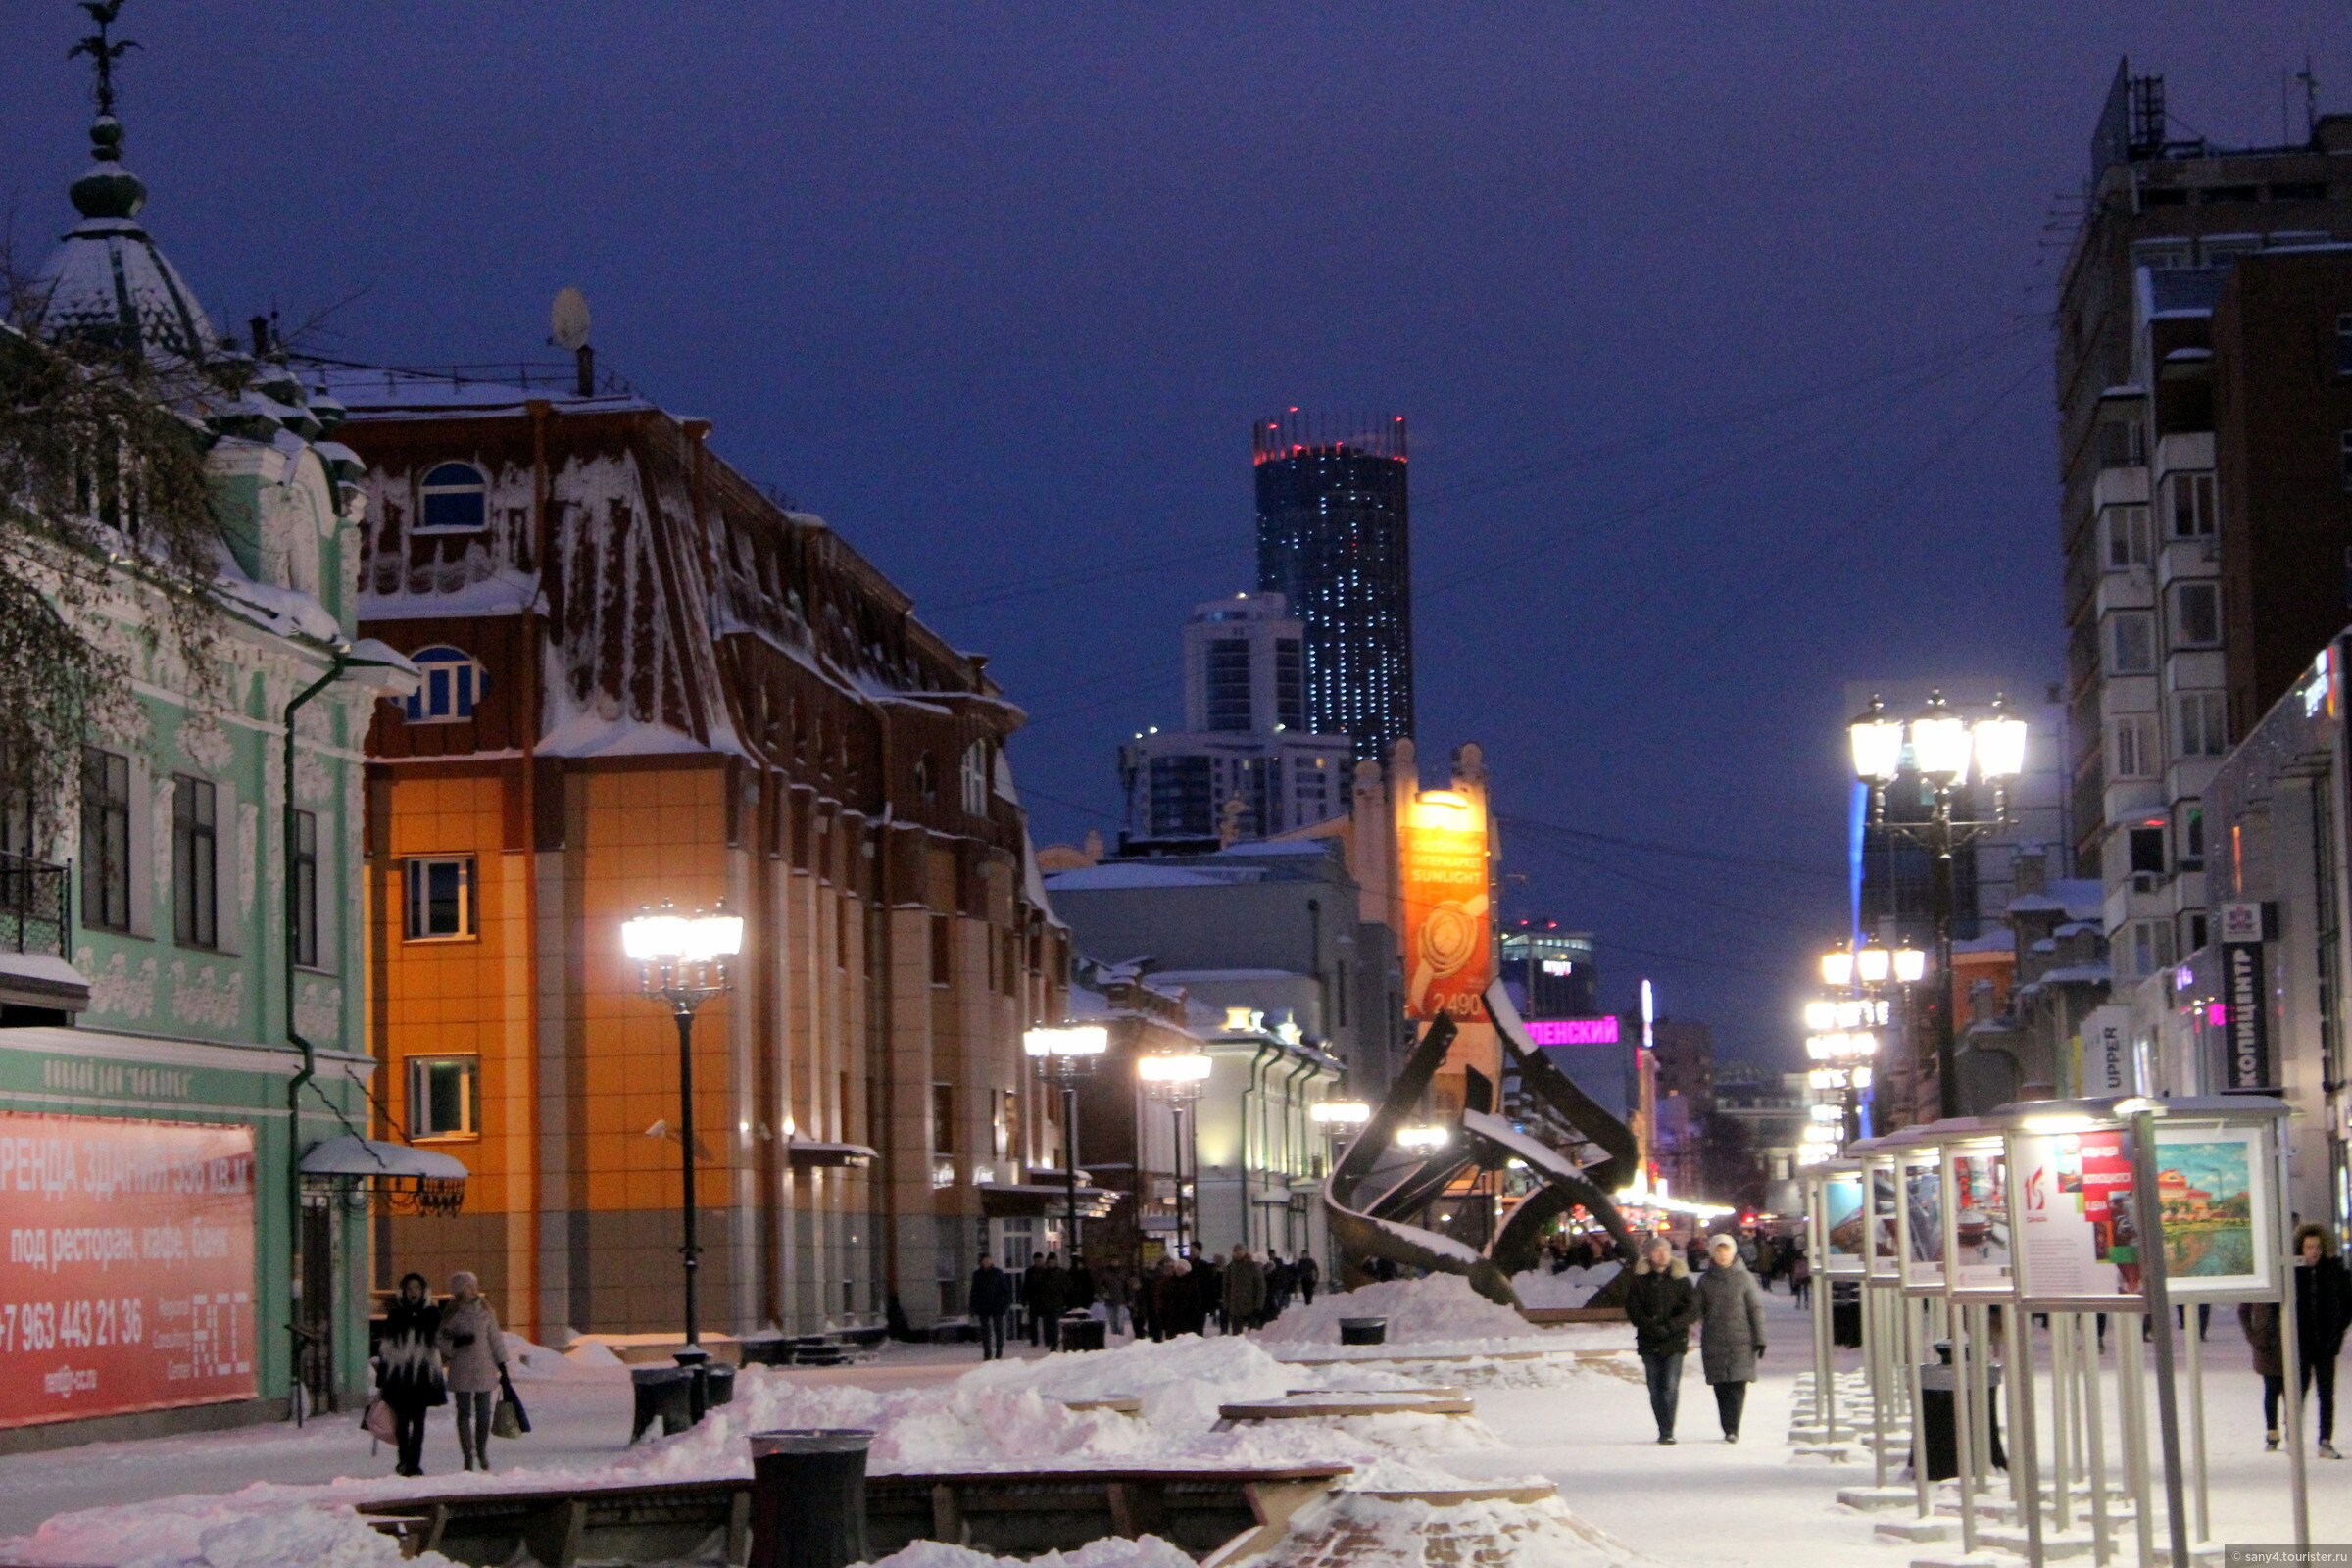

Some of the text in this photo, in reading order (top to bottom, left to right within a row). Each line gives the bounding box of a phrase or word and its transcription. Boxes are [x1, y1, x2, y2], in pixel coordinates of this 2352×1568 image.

[1411, 869, 1482, 884] SUNLIGHT
[2104, 1027, 2121, 1089] UPPER
[11, 1227, 48, 1271] под
[22, 1301, 55, 1352] 963
[60, 1299, 93, 1348] 443
[96, 1298, 117, 1346] 21
[122, 1296, 143, 1344] 36
